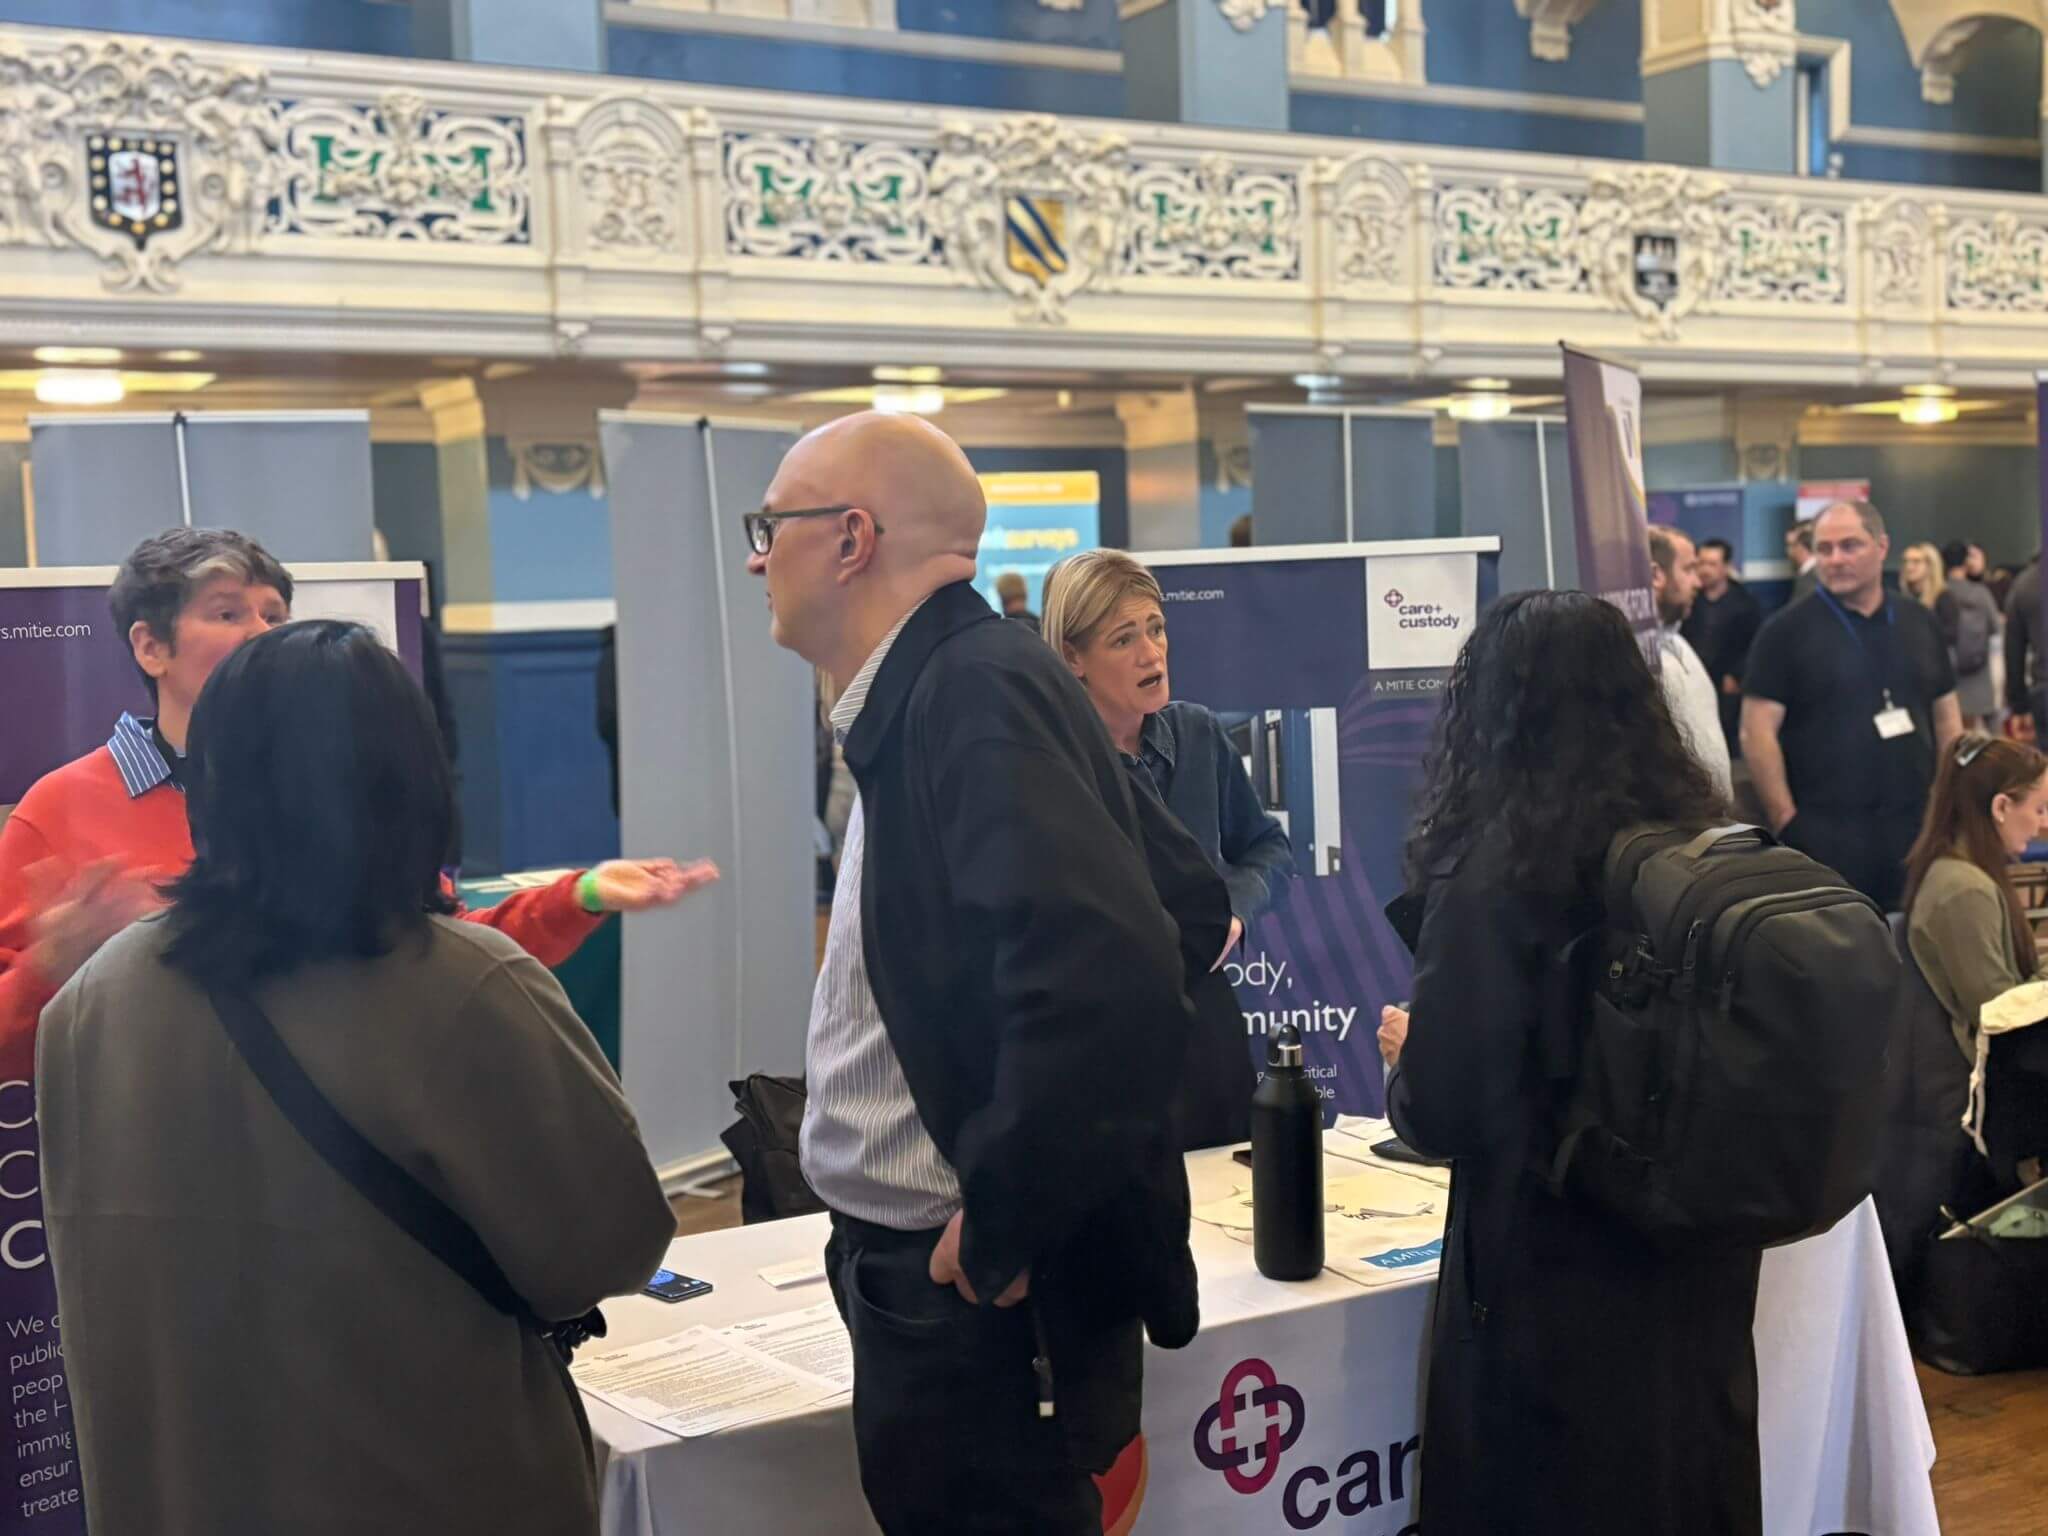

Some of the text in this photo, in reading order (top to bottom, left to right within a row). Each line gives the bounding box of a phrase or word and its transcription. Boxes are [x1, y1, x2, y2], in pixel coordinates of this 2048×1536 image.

[1399, 604, 1442, 615] care+
[1399, 614, 1460, 629] custody
[0, 621, 92, 639] s.mitie.com
[1375, 680, 1384, 692] A
[1386, 680, 1415, 691] MITIE
[6, 1315, 45, 1339] We
[13, 1408, 48, 1429] the
